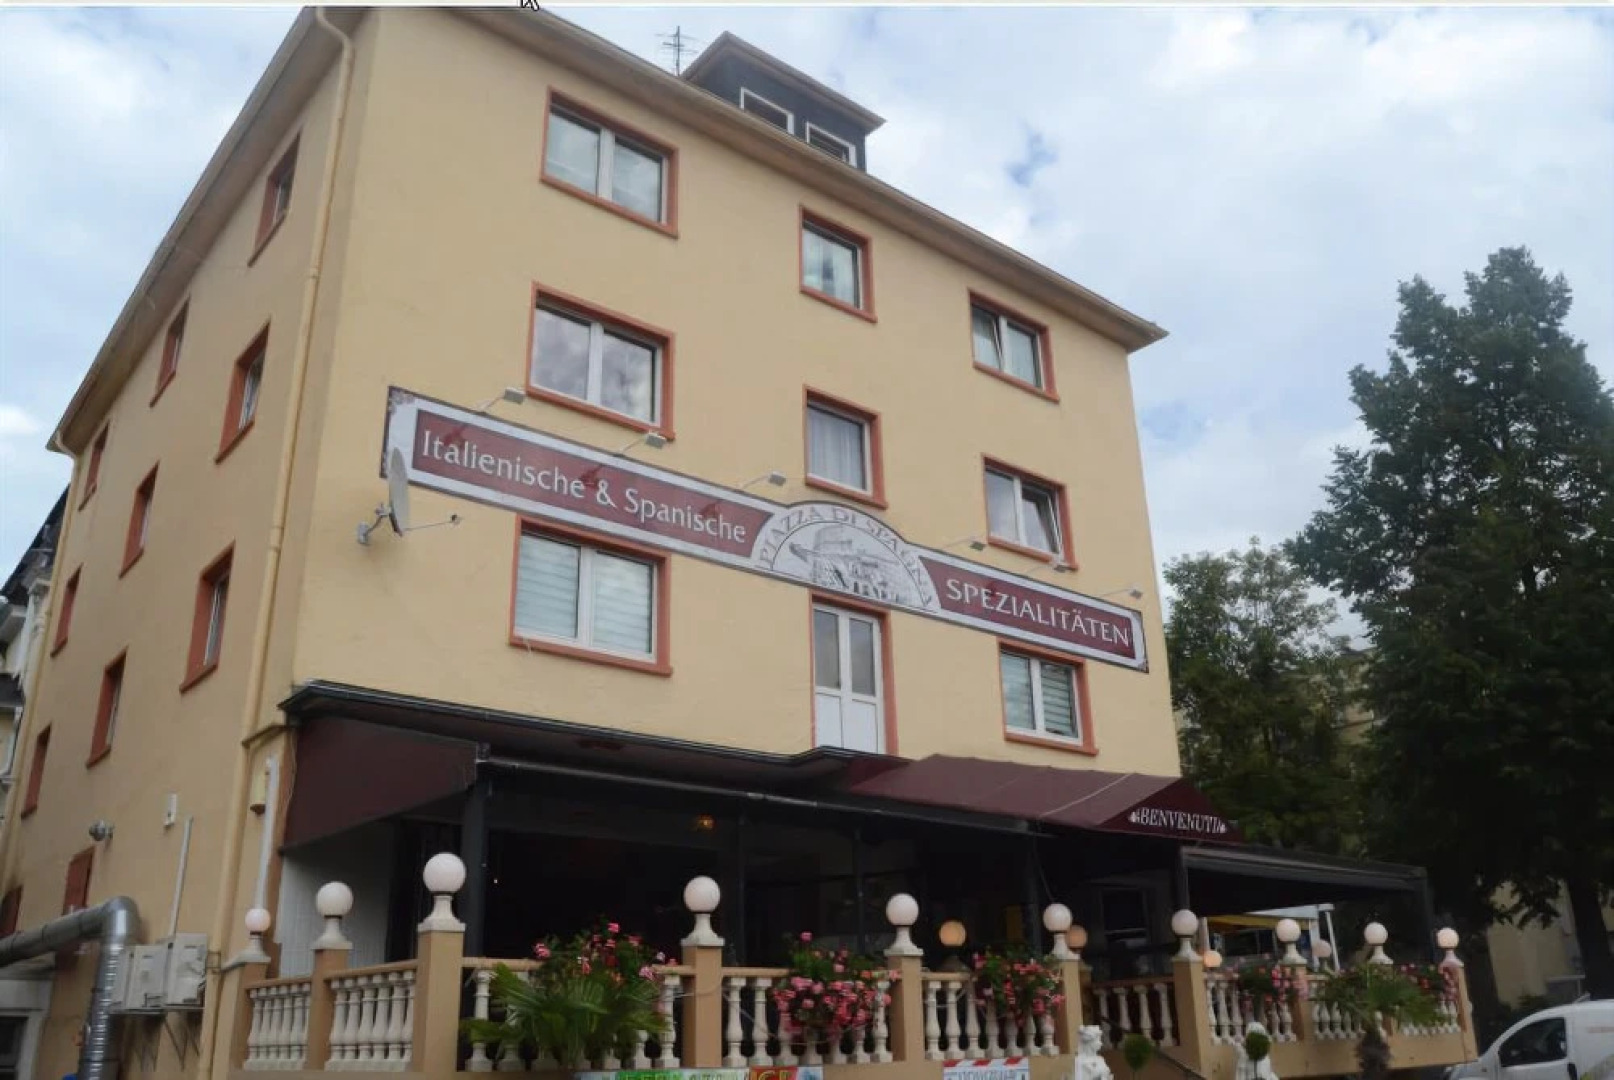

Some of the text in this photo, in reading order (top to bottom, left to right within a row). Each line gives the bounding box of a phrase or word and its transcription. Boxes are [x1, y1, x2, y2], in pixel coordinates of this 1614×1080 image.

[421, 430, 746, 544] Italienische & Spanische
[759, 506, 824, 563] PIAZZA
[832, 507, 856, 525] DI
[946, 578, 1129, 647] SPEZIALITÄTEN
